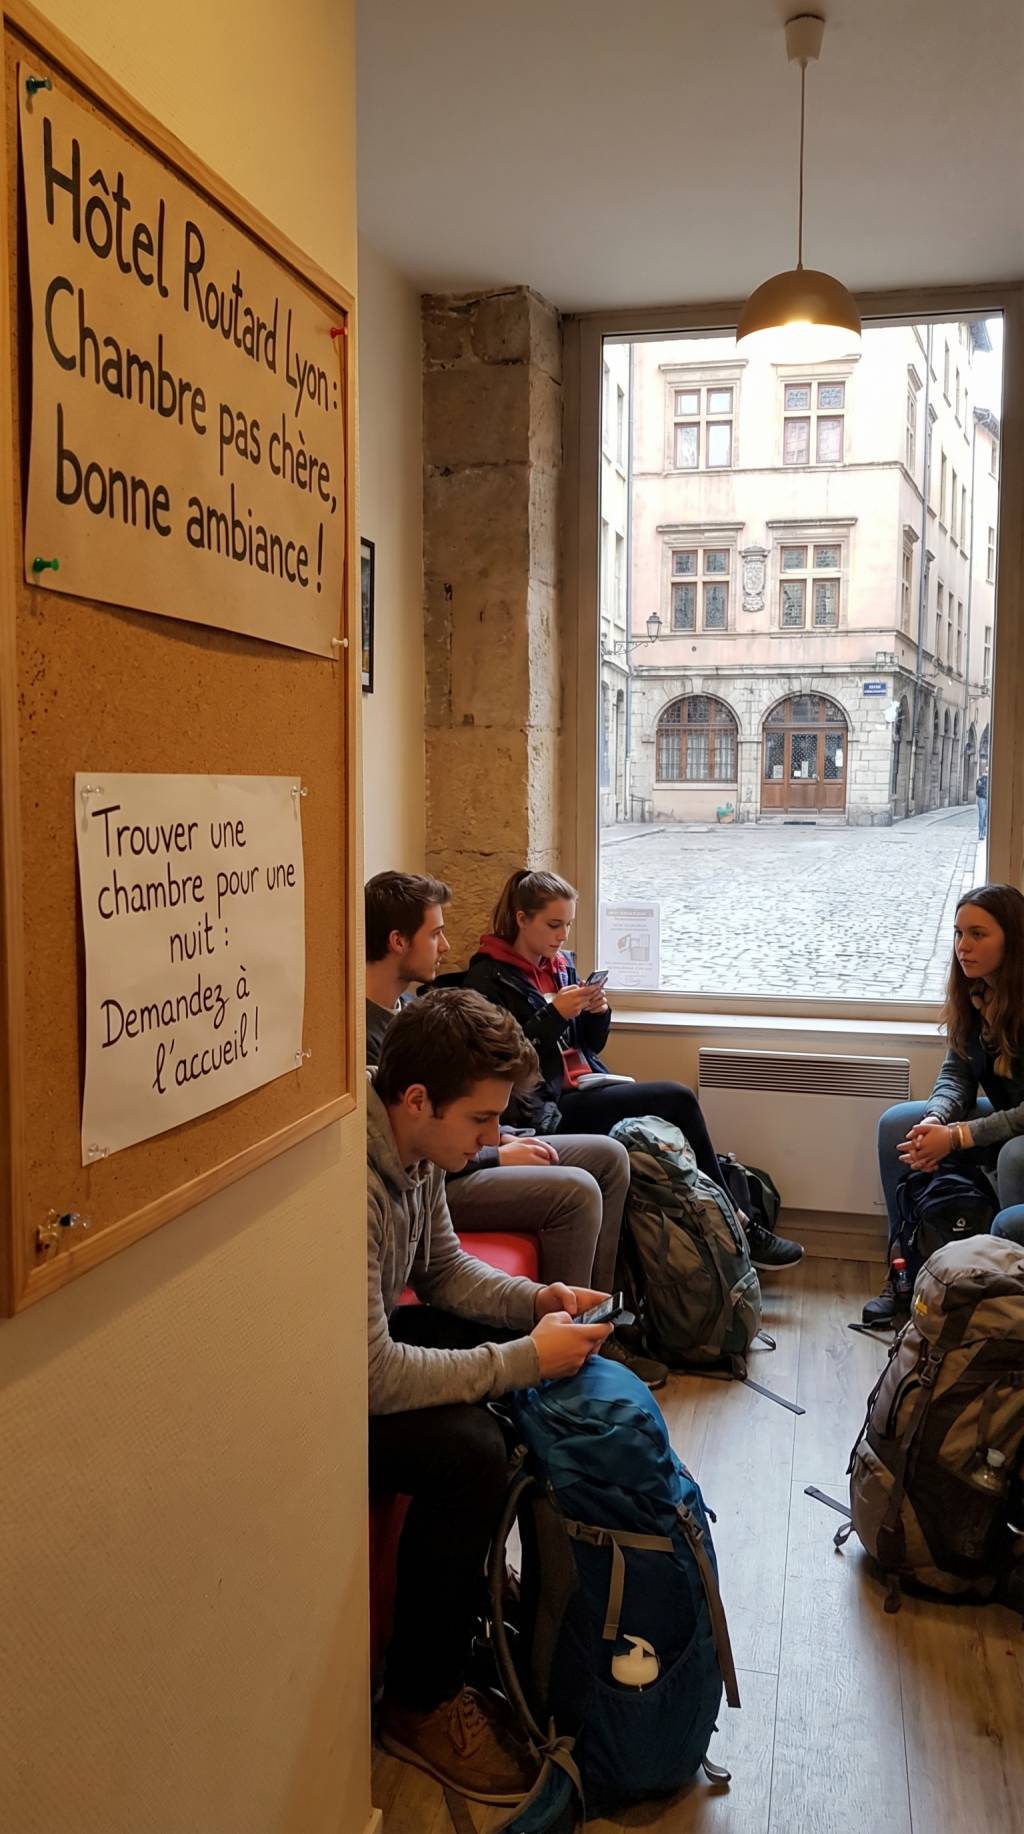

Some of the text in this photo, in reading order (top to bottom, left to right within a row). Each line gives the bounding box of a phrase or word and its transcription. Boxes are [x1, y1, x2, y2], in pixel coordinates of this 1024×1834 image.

[42, 116, 170, 299] Hôtel
[183, 220, 279, 375] Routard
[44, 275, 338, 515] Chambre pas chère,
[55, 402, 172, 538] bonne
[91, 804, 247, 858] Trouver une
[97, 861, 297, 920] chambre pour une
[99, 964, 251, 1049] Demandez à
